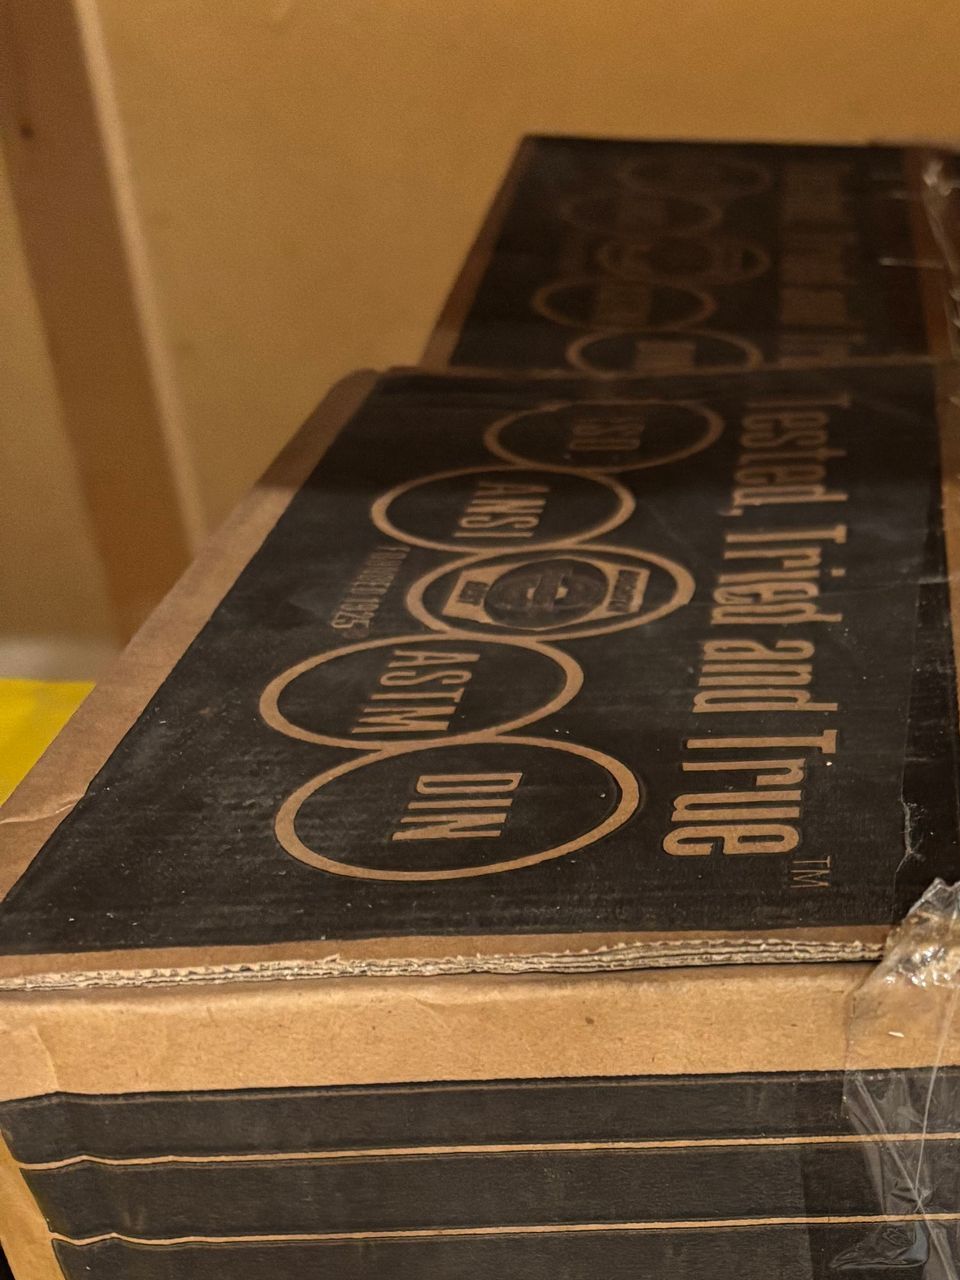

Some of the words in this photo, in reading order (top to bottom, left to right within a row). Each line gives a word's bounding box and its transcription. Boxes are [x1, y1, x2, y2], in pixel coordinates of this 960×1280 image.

[454, 481, 550, 538] ANSI
[710, 524, 848, 626] Tried
[350, 649, 481, 734] ASTM
[692, 638, 840, 714] and
[391, 771, 523, 841] DIN
[662, 729, 839, 857] True
